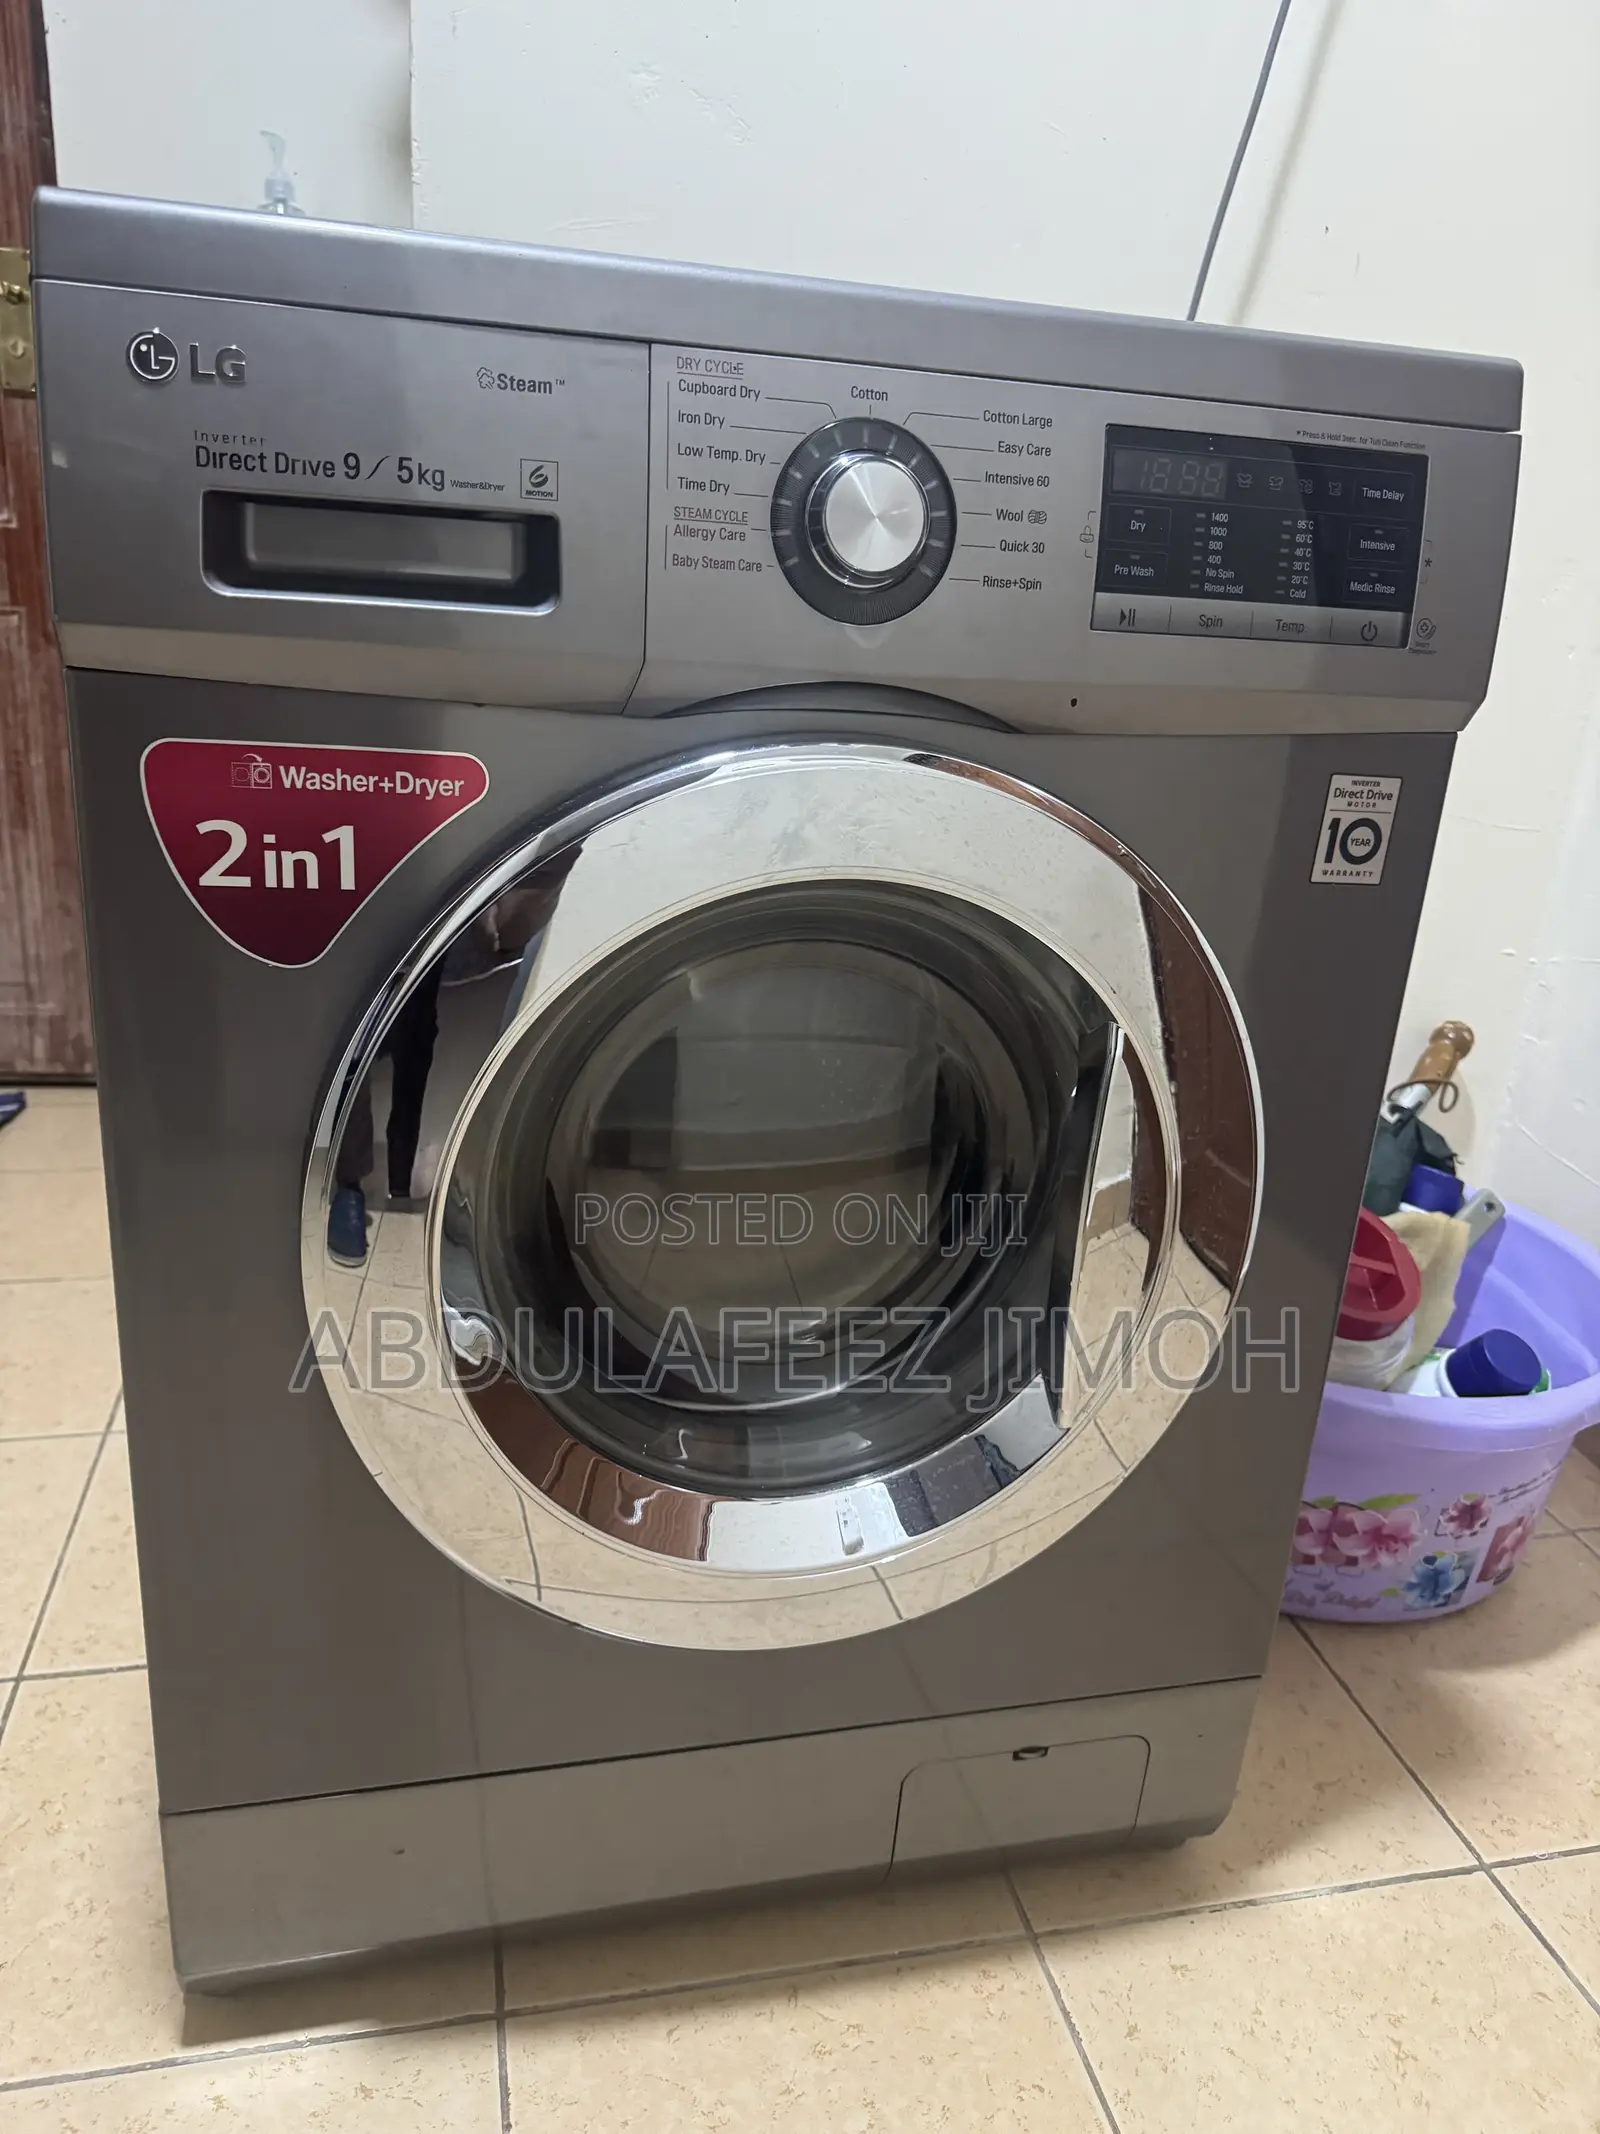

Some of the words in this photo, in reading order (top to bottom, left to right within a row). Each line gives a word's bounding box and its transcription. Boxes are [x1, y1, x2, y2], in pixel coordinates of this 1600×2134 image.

[189, 342, 246, 383] LG
[677, 356, 701, 371] DRY
[704, 359, 744, 376] CYCLE
[678, 378, 737, 397] Cupboard
[740, 385, 760, 402] Dry
[850, 385, 889, 401] Cotton
[678, 409, 701, 425] Iron
[704, 412, 725, 430] Dry
[983, 409, 1020, 425] Cotton
[1022, 412, 1053, 429] Large
[194, 430, 265, 447] Inverter
[677, 442, 704, 457] Low
[706, 445, 742, 463] Temp.
[745, 449, 766, 466] Dry
[998, 440, 1025, 457] Easy
[1026, 442, 1052, 457] Care
[195, 445, 267, 473] Direct
[275, 452, 336, 479] Drive
[450, 480, 505, 492] Washer&Dryer
[677, 476, 706, 492] Time
[709, 479, 730, 496] Dry
[984, 470, 1034, 487] Intensive
[1036, 475, 1050, 487] 60
[525, 490, 553, 498] MOTION
[1362, 486, 1382, 499] Time
[1383, 488, 1405, 502] Delay
[673, 505, 712, 520] STEAM
[714, 509, 748, 523] CYCLE
[996, 507, 1024, 522] Wool
[1211, 512, 1229, 523] 1400
[673, 524, 716, 542] Allergy
[719, 527, 746, 542] Care
[1130, 520, 1146, 532] Dry
[1210, 526, 1228, 537] 1000
[1000, 539, 1030, 553] Quick
[1031, 541, 1045, 554] 30
[1208, 540, 1223, 551] 800
[1360, 538, 1396, 551] Intensive
[672, 553, 700, 570] Baby
[701, 555, 736, 571] Steam
[738, 558, 763, 573] Care
[1207, 554, 1222, 565] 400
[1114, 564, 1129, 575] Pre
[1130, 565, 1155, 577] Wash
[1205, 567, 1217, 578] No
[1217, 568, 1235, 580] Spin
[982, 575, 1043, 592] Rinse+Spin
[1203, 582, 1224, 593] Rinse
[1225, 584, 1244, 595] Hold
[1349, 581, 1374, 593] Medic
[1374, 583, 1396, 595] Rinse
[1289, 588, 1307, 599] Cold
[1199, 614, 1223, 629] Spin
[278, 764, 465, 801] Washer+Dryer
[1351, 780, 1381, 788] INVERTER
[1333, 787, 1365, 800] Direct
[1366, 789, 1394, 801] Drive
[1347, 801, 1377, 809] MOTOR
[1324, 817, 1383, 866] 10
[1350, 838, 1371, 847] YEAR
[1322, 869, 1373, 878] WARRANTY
